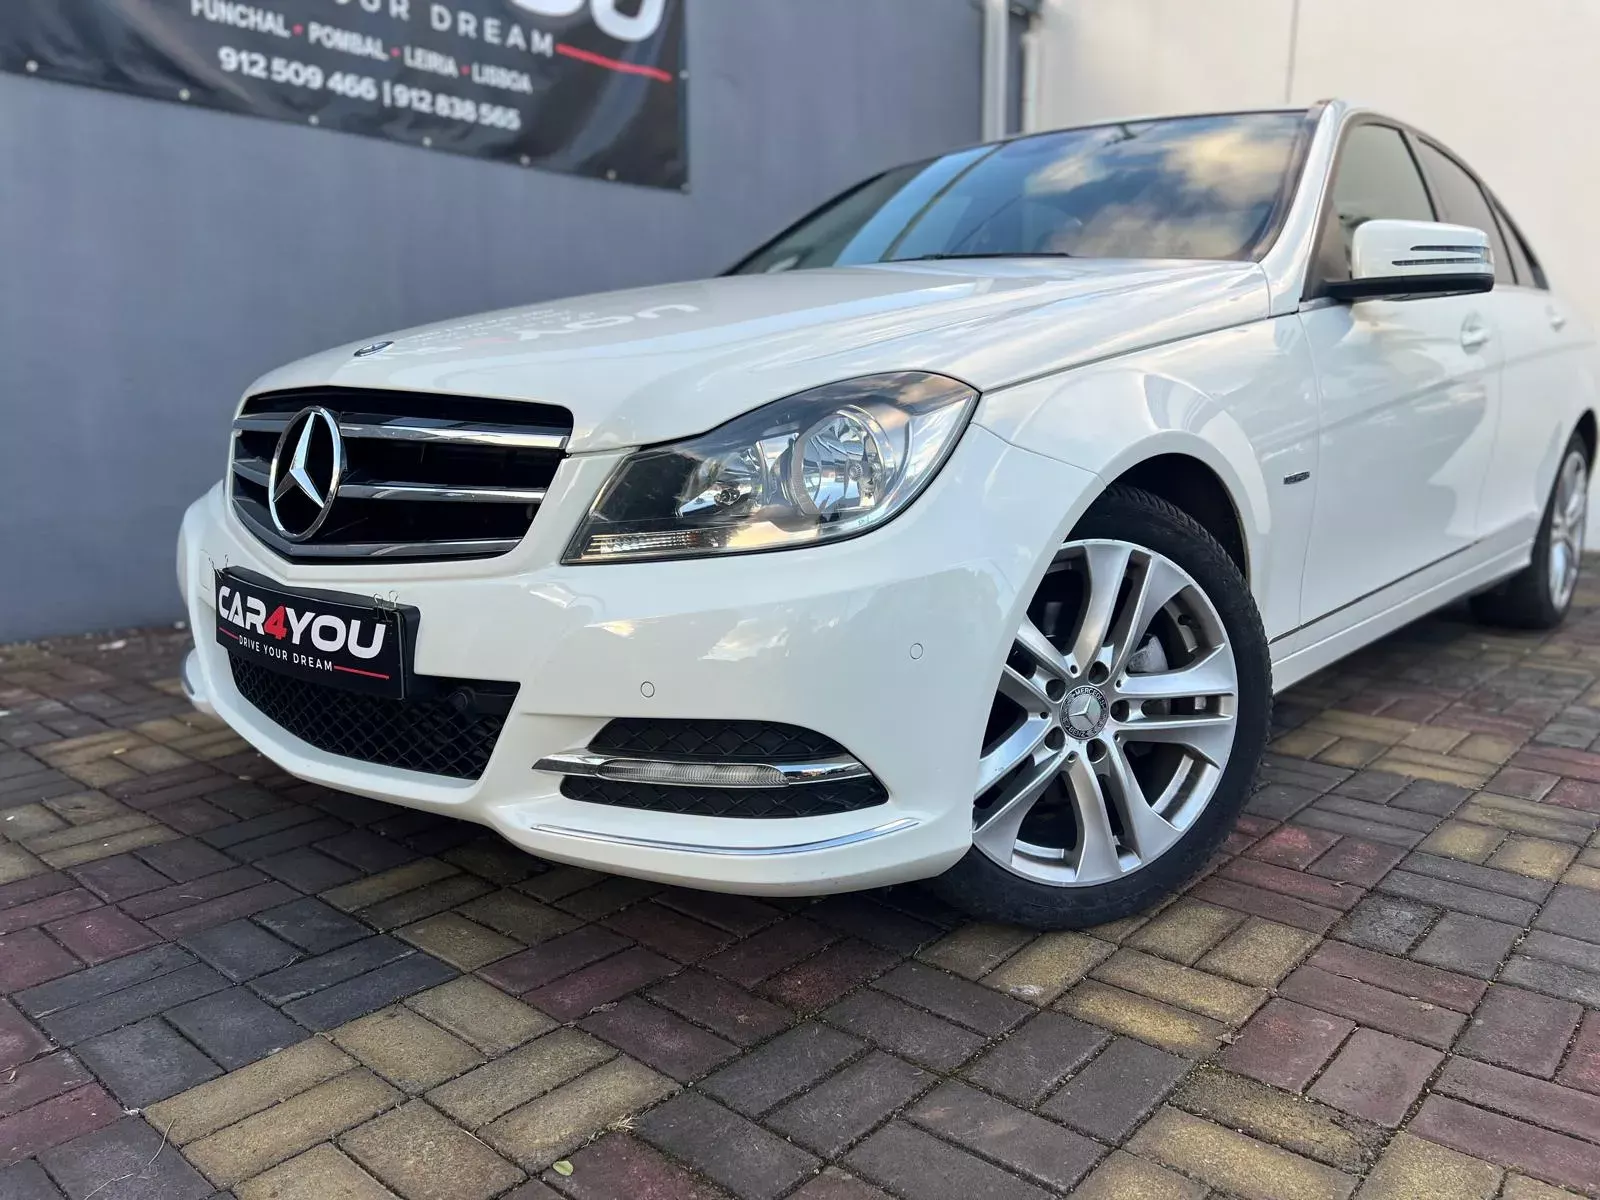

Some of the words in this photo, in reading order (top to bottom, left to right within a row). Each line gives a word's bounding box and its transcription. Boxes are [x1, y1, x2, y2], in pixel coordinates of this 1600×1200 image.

[189, 0, 291, 38] FUNCHAL
[308, 21, 389, 61] POMBAL
[430, 3, 553, 57] DREAM
[218, 46, 268, 80] 912
[270, 57, 324, 90] 509
[326, 71, 378, 102] 466
[393, 84, 433, 114] 912
[218, 585, 387, 660] CAR4YOU
[238, 634, 261, 652] DRIVE
[263, 643, 289, 662] YOUR
[293, 653, 333, 672] DREAM
